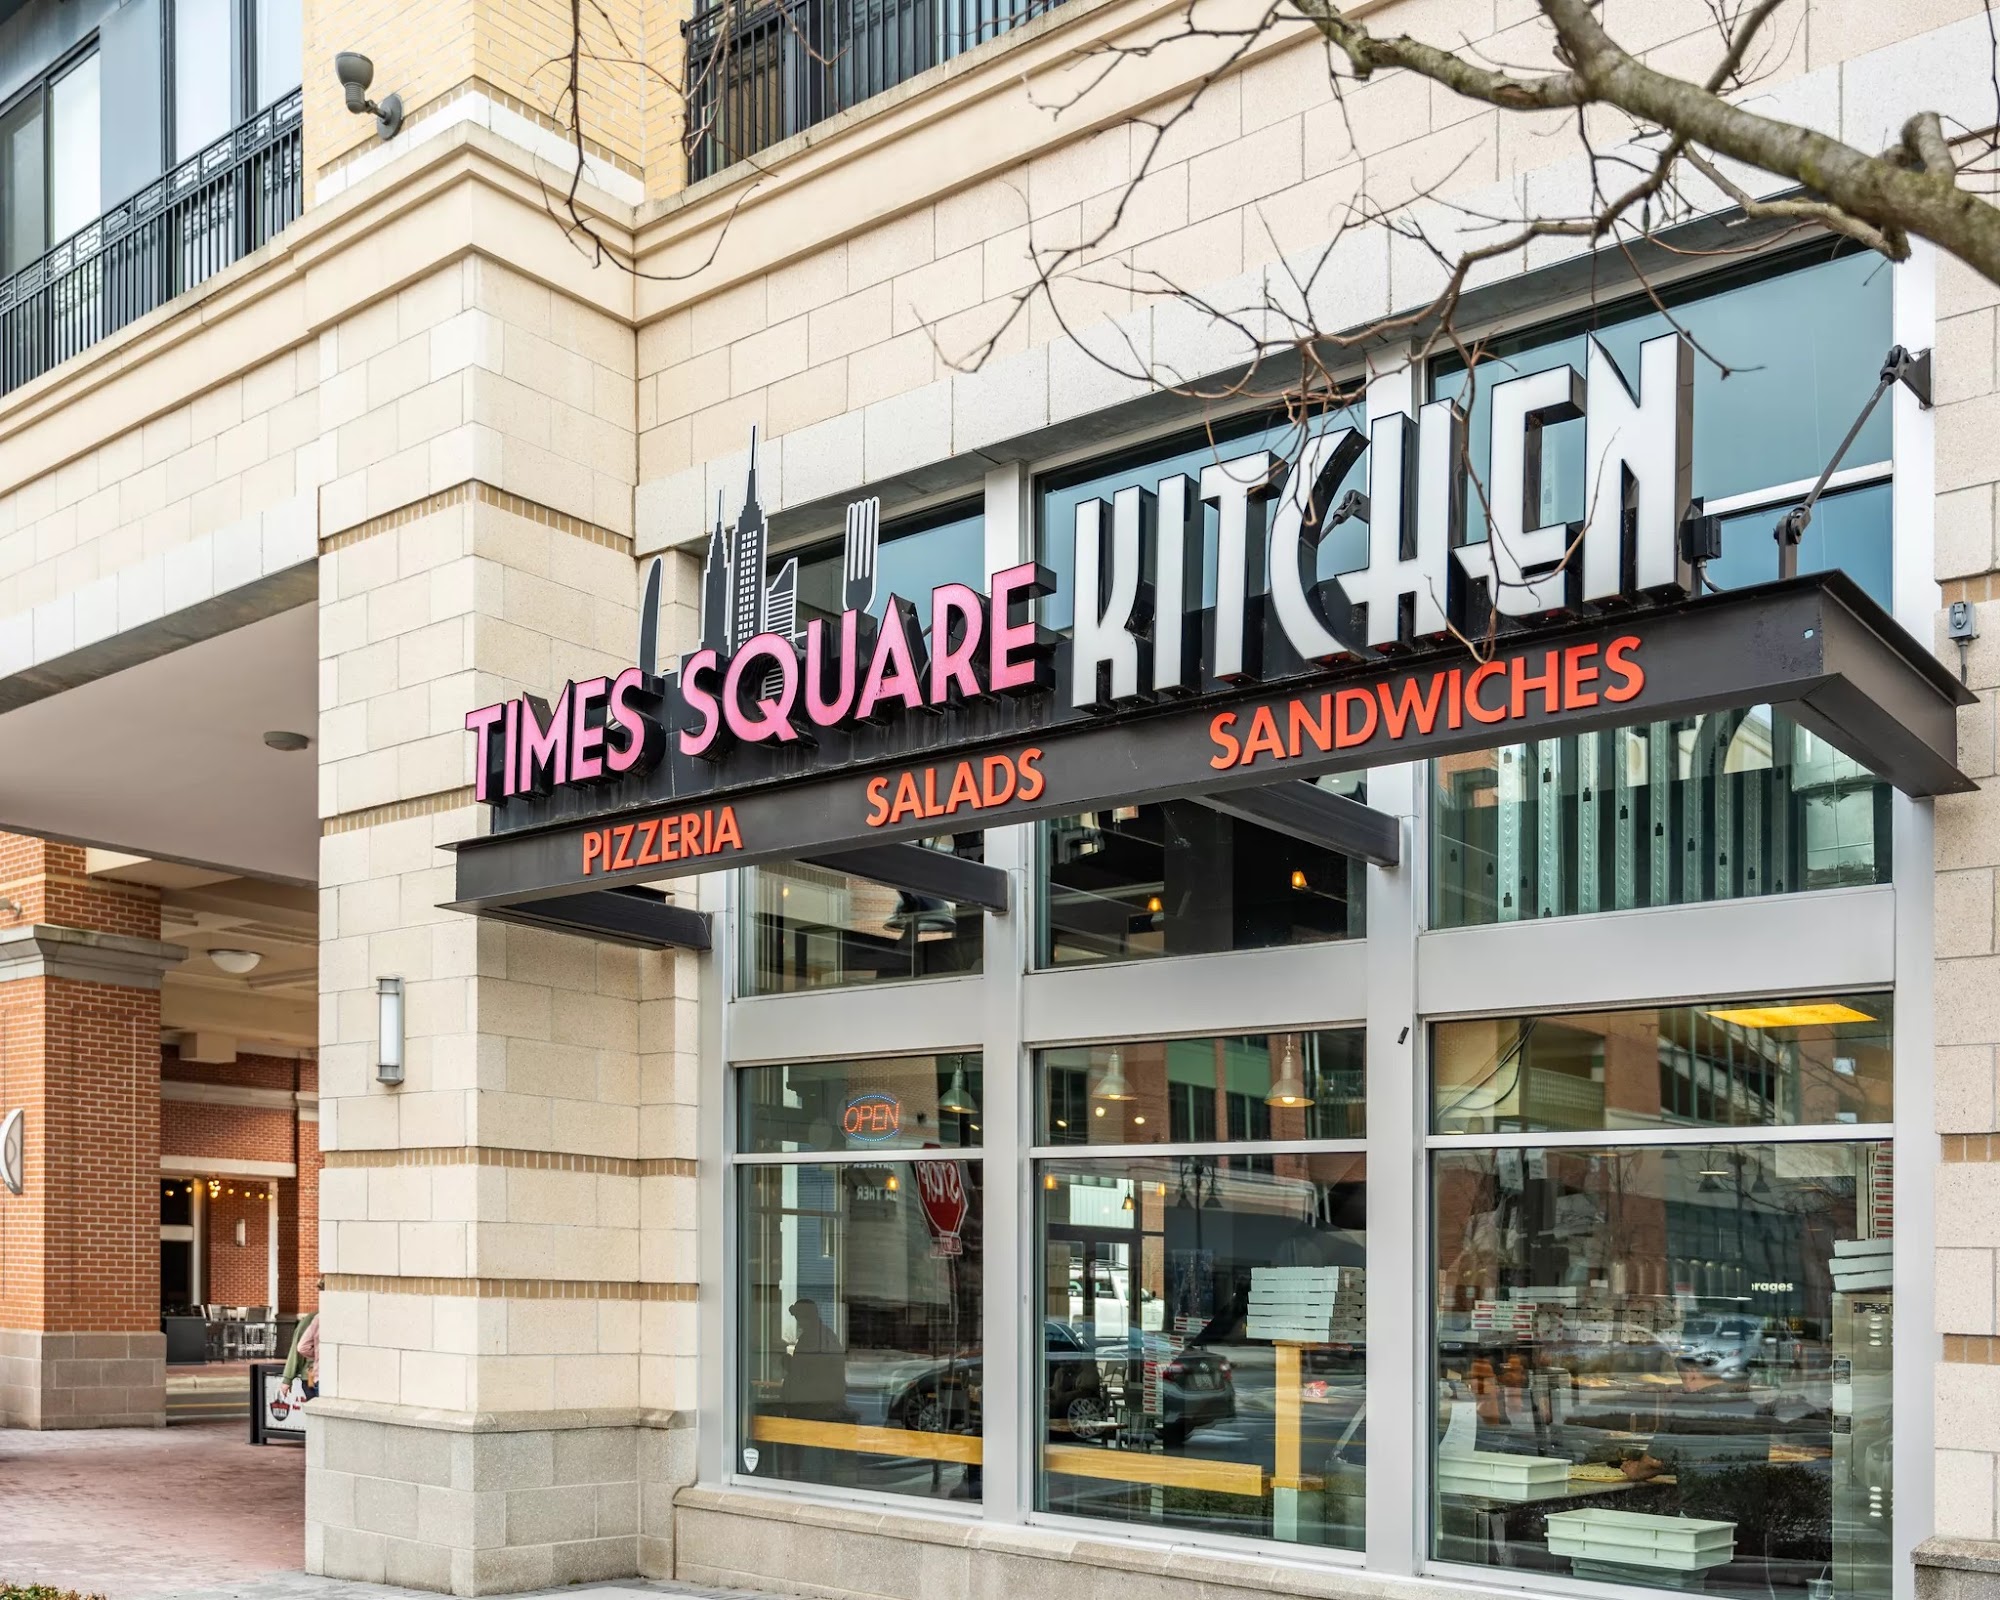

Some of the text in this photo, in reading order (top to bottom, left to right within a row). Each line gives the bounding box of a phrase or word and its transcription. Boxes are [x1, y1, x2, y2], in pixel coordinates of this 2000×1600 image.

[465, 331, 1678, 802] TIMES SQUARE KITCHEN
[1209, 636, 1645, 770] SANDWICHES
[866, 748, 1046, 827] SALADS
[582, 806, 743, 874] PIZZERIA
[843, 1103, 900, 1132] OPEN
